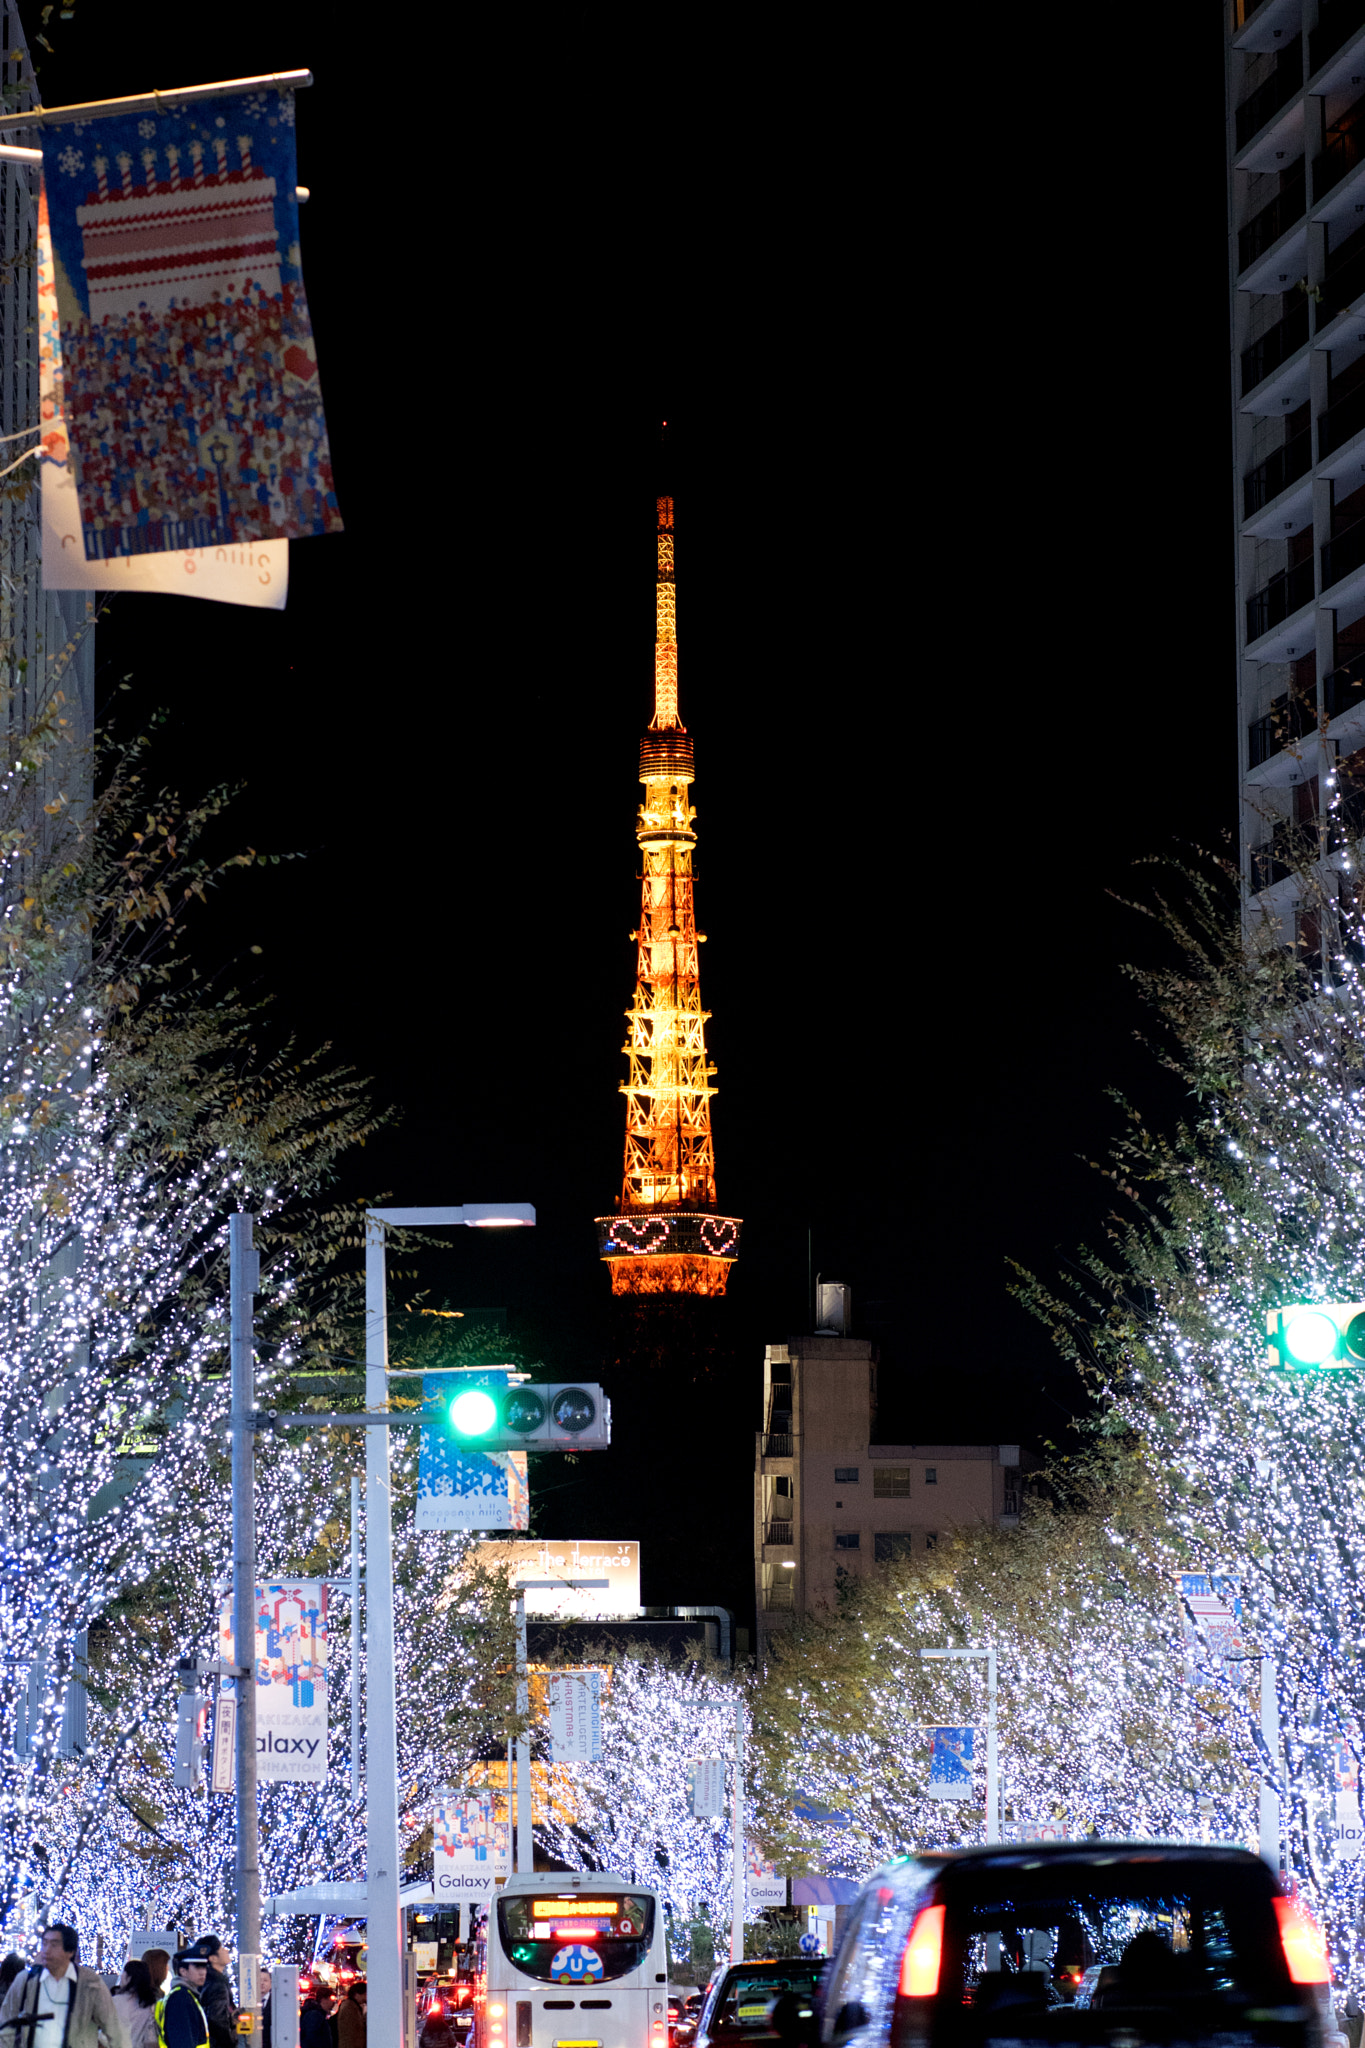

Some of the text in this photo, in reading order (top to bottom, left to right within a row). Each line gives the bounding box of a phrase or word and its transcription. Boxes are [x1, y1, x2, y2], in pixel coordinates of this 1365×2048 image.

[478, 1503, 502, 1523] hills
[617, 1546, 631, 1555] 3F
[537, 1551, 566, 1568] The
[571, 1551, 631, 1568] Terrace
[257, 1714, 322, 1726] AKIZAKA
[256, 1730, 320, 1759] alaxy
[592, 1731, 601, 1760] HILLS
[438, 1874, 491, 1890] Galaxy
[750, 1887, 784, 1898] Galaxy
[619, 1919, 632, 1934] Q
